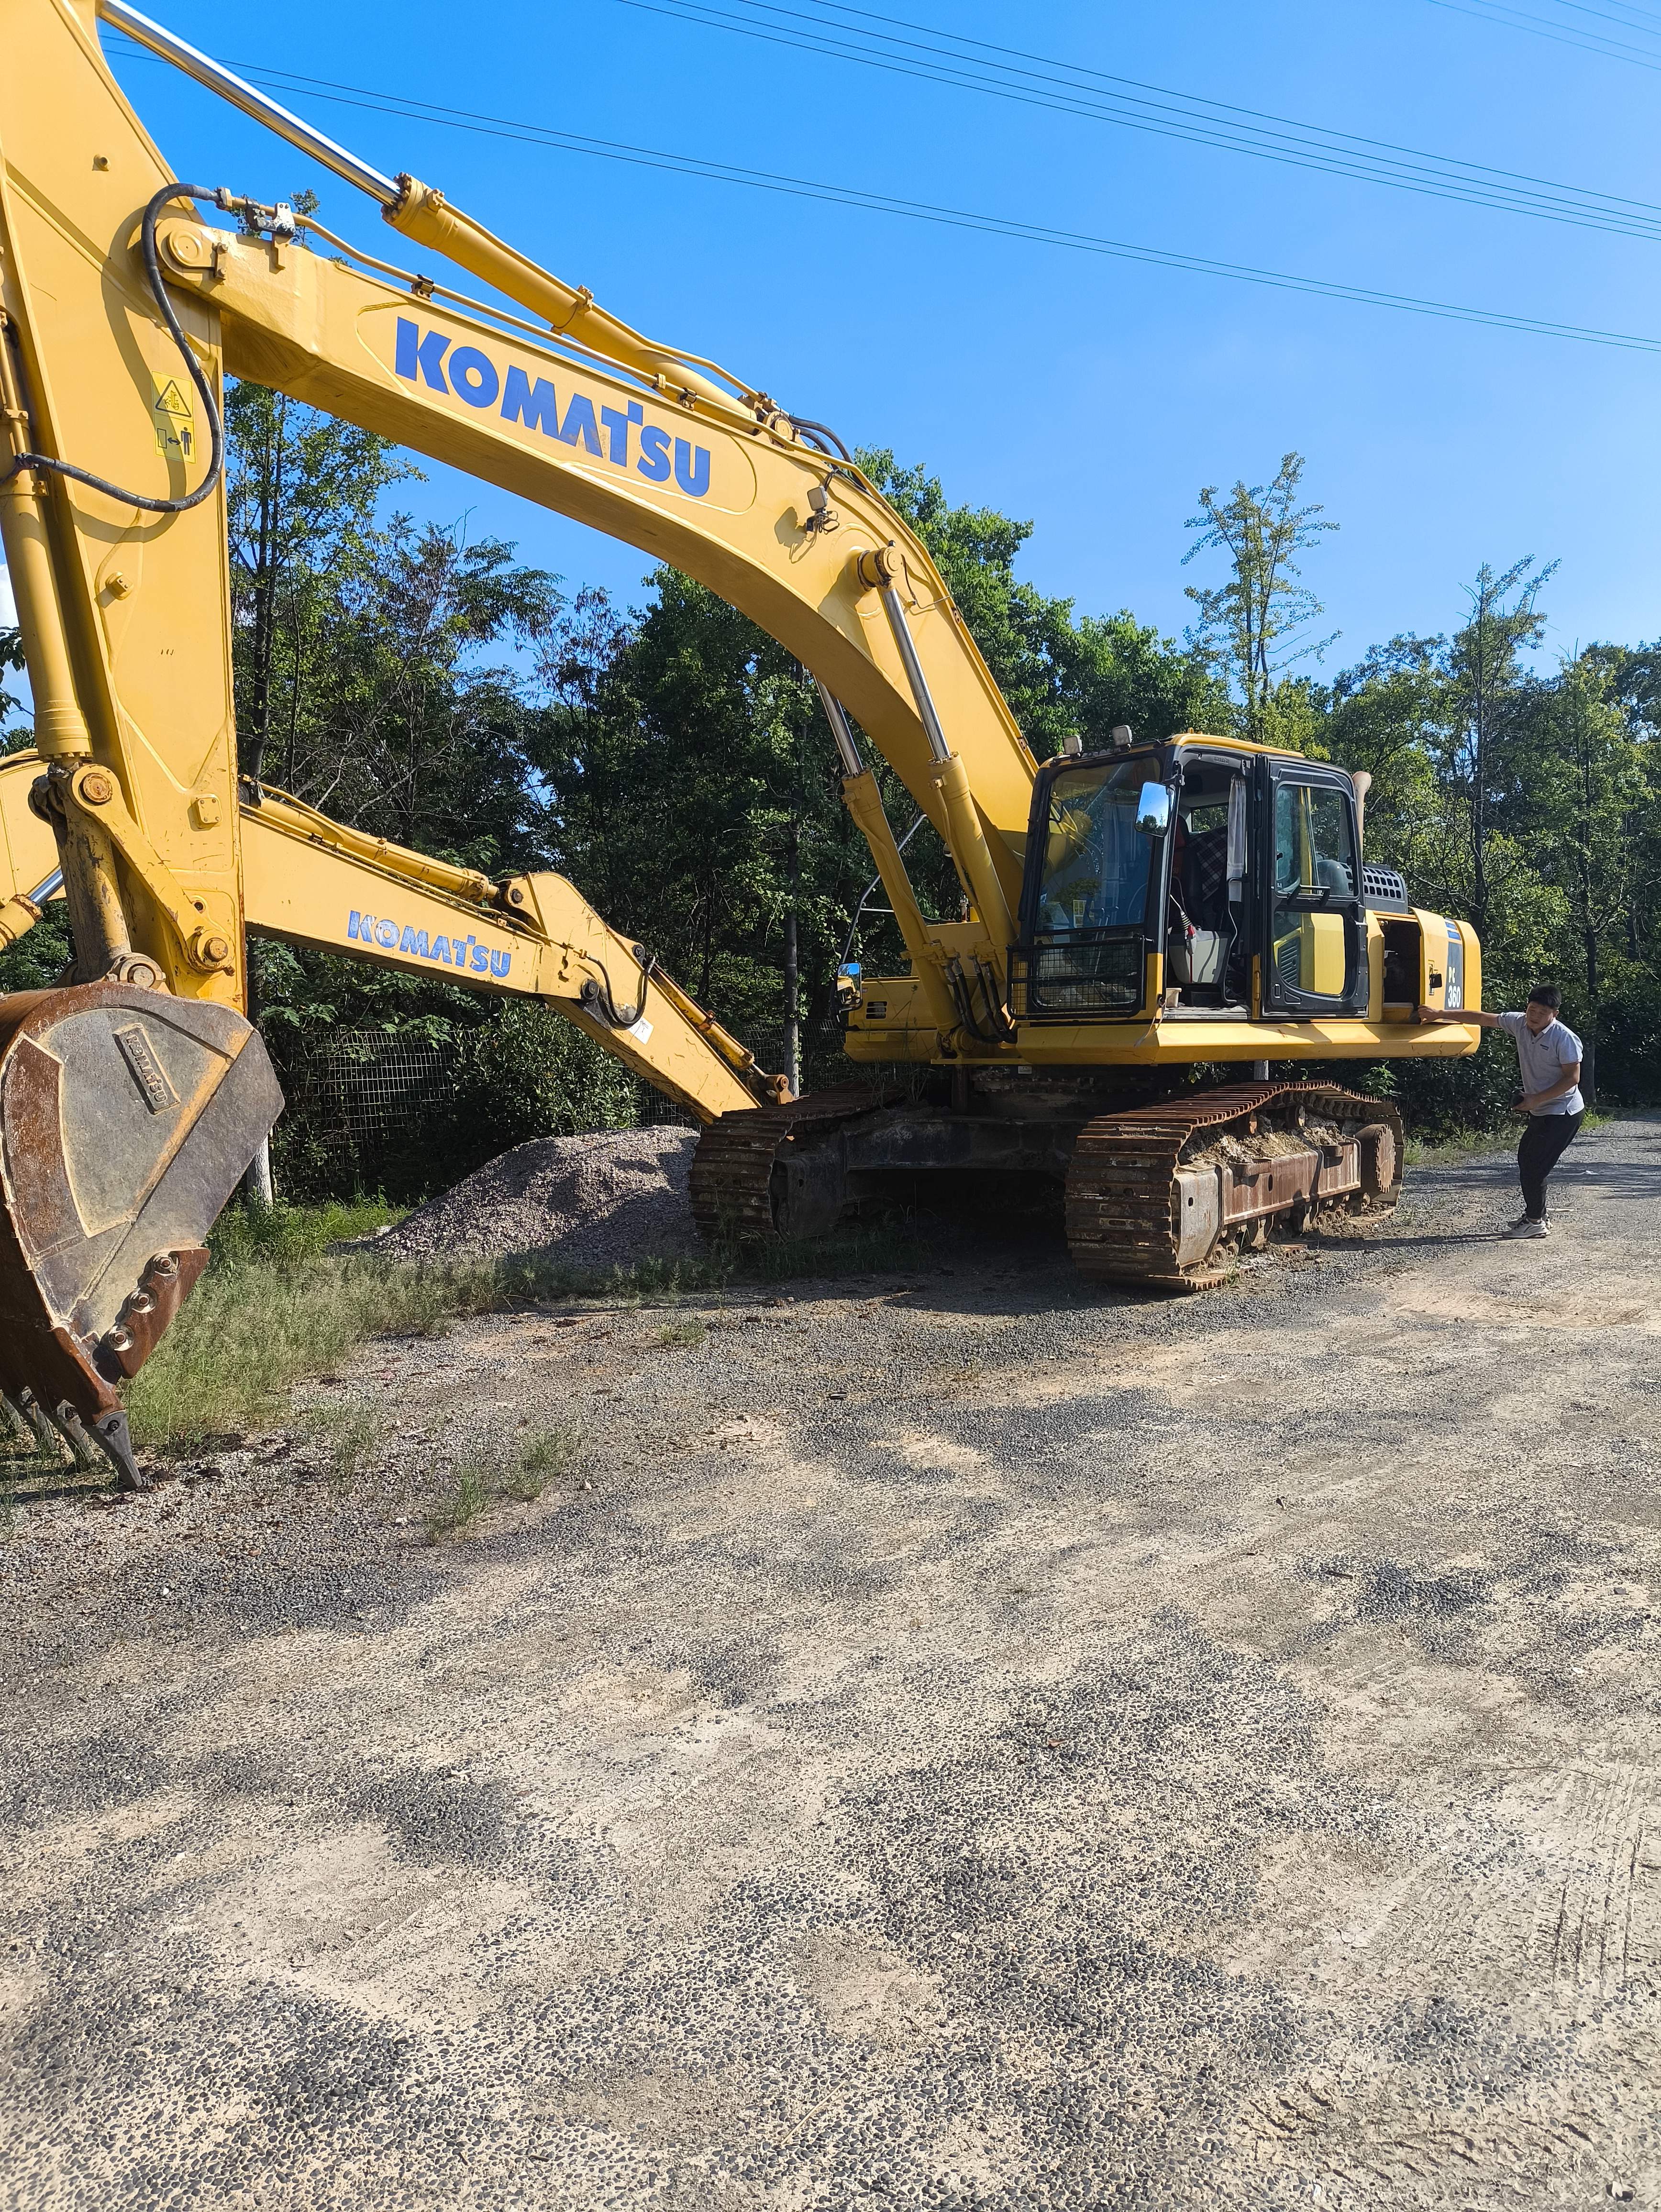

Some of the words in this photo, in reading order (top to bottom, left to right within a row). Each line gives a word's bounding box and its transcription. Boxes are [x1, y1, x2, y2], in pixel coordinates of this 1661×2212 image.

[395, 316, 710, 497] KOMATSU
[347, 910, 511, 977] KOMATSU
[1449, 966, 1455, 984] PC
[1448, 985, 1461, 1008] 360
[126, 1035, 167, 1102] KOMATSU
